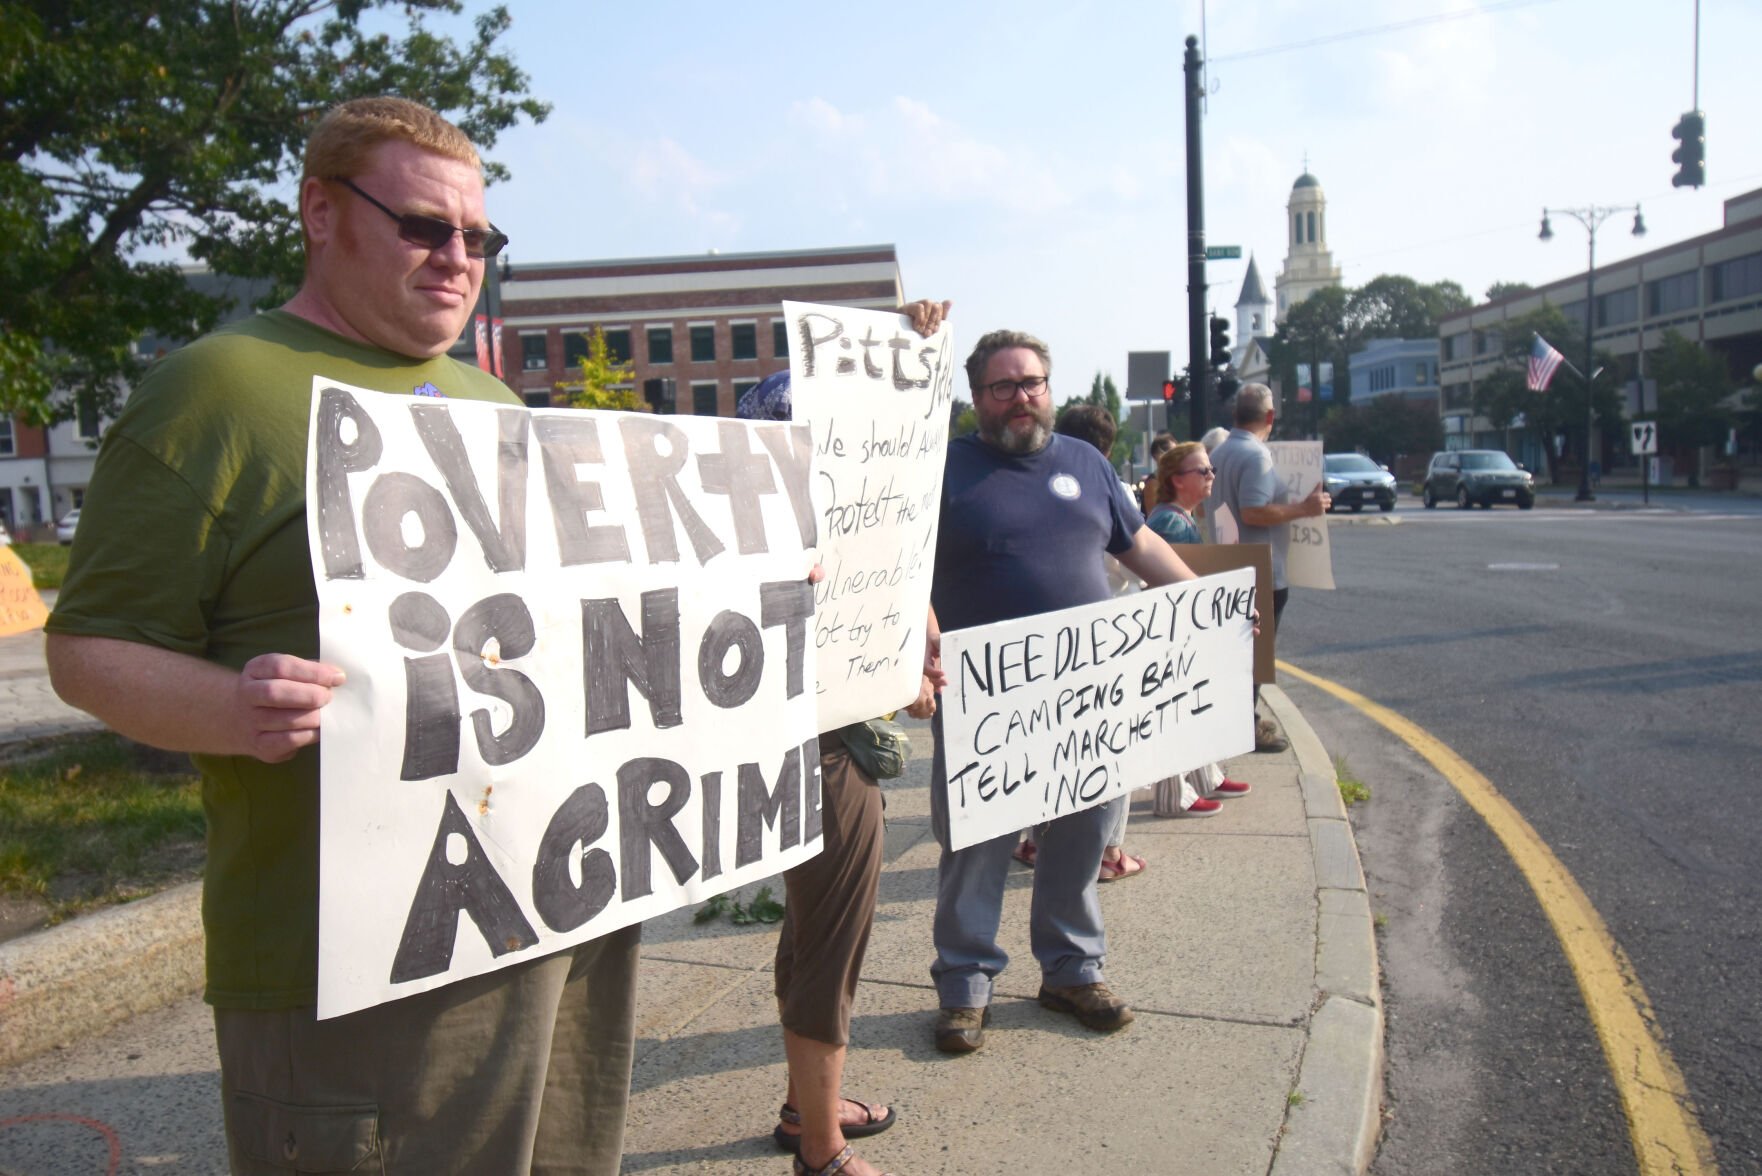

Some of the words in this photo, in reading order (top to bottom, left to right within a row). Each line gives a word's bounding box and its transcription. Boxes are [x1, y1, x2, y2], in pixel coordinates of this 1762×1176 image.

[860, 419, 916, 463] should
[581, 579, 816, 738] NOT
[848, 604, 873, 647] try
[881, 602, 901, 629] to
[961, 590, 1187, 714] NEEDLESSLY
[1191, 586, 1256, 630] CRUEL
[949, 753, 1037, 808] TELL
[1053, 678, 1214, 771] MARCHETTI
[974, 673, 1124, 755] CAMPING
[1140, 650, 1197, 698] BAN
[389, 788, 540, 985] A
[531, 737, 824, 934] CRIME
